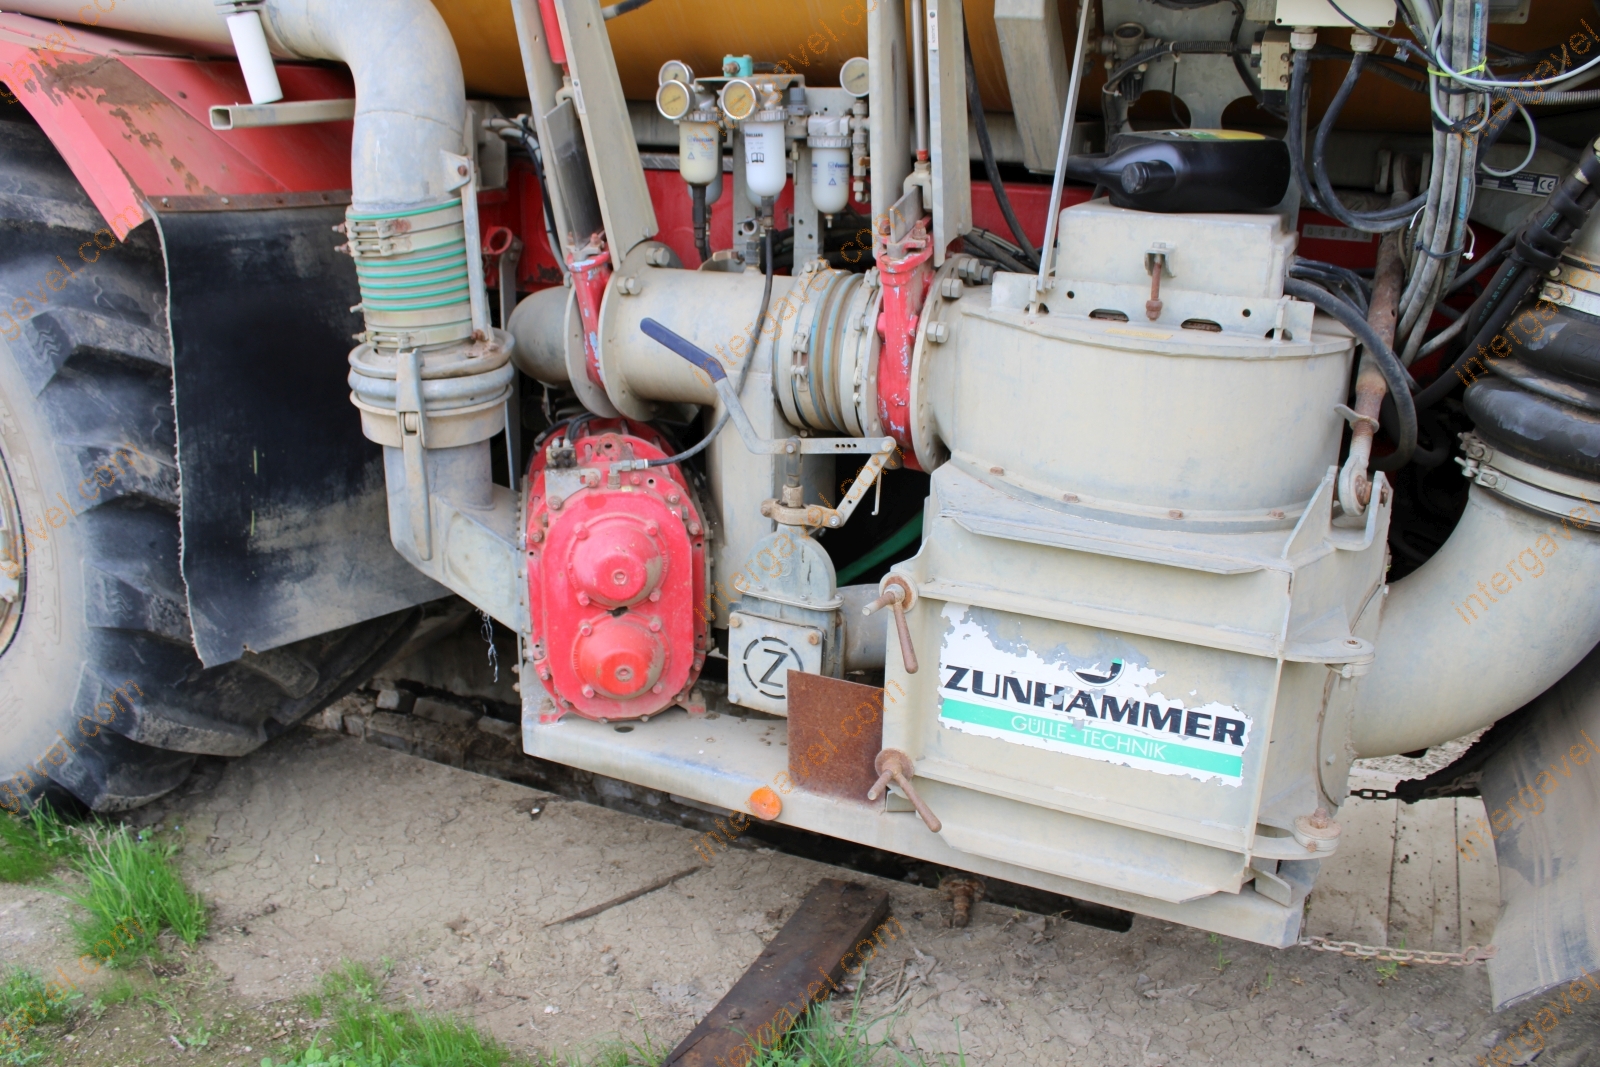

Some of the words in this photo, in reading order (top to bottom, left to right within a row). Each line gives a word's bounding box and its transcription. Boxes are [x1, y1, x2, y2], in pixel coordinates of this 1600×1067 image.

[944, 664, 1246, 747] ZUNHAMMER
[1011, 715, 1067, 740] GÜLLE
[1082, 728, 1168, 760] TECHNIK
